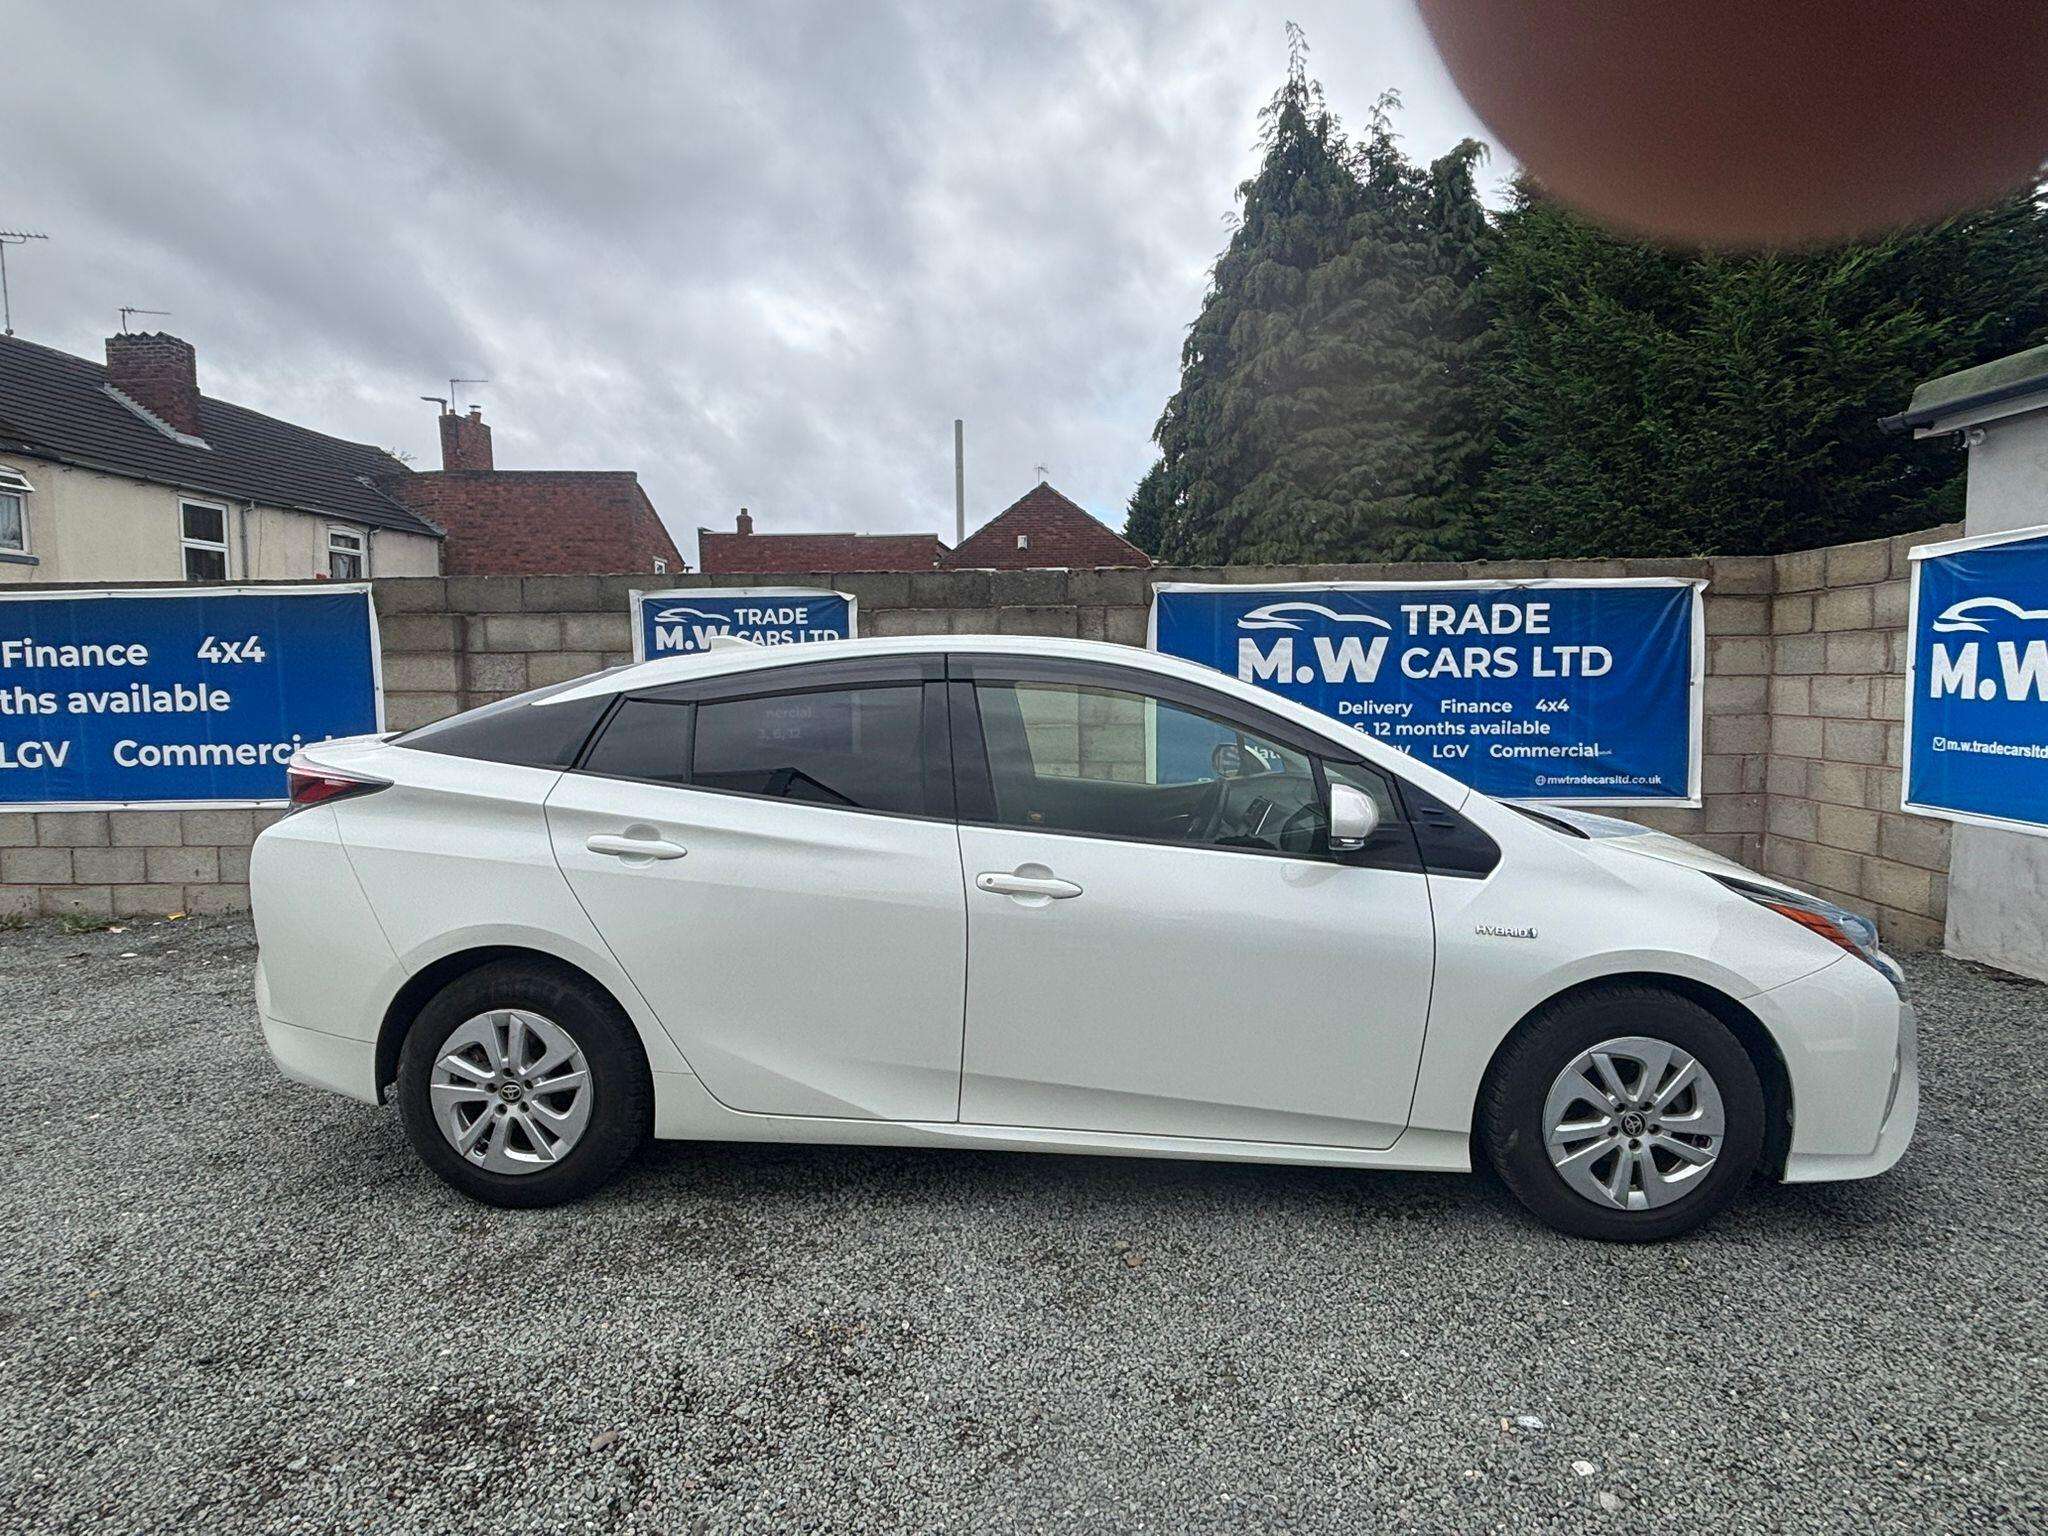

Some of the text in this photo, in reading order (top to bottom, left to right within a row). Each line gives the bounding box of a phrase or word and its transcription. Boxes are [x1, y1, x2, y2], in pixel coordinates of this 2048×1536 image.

[733, 607, 809, 625] TRADE
[1400, 602, 1551, 636] TRADE
[1, 635, 266, 668] Finance 4x4
[1238, 636, 1389, 684] M.W
[1400, 645, 1613, 679] CARS LTD
[68, 682, 231, 714] available
[1338, 698, 1570, 718] Delivery Finance 4x4
[1372, 721, 1391, 736] 12
[1395, 721, 1466, 736] months
[1469, 719, 1551, 735] available
[0, 740, 70, 769] LGV
[1432, 742, 1599, 758] LGV Commercial
[1547, 774, 1662, 785] mwtradecarsltd.co.uk
[1475, 924, 1529, 938] HYBRID
